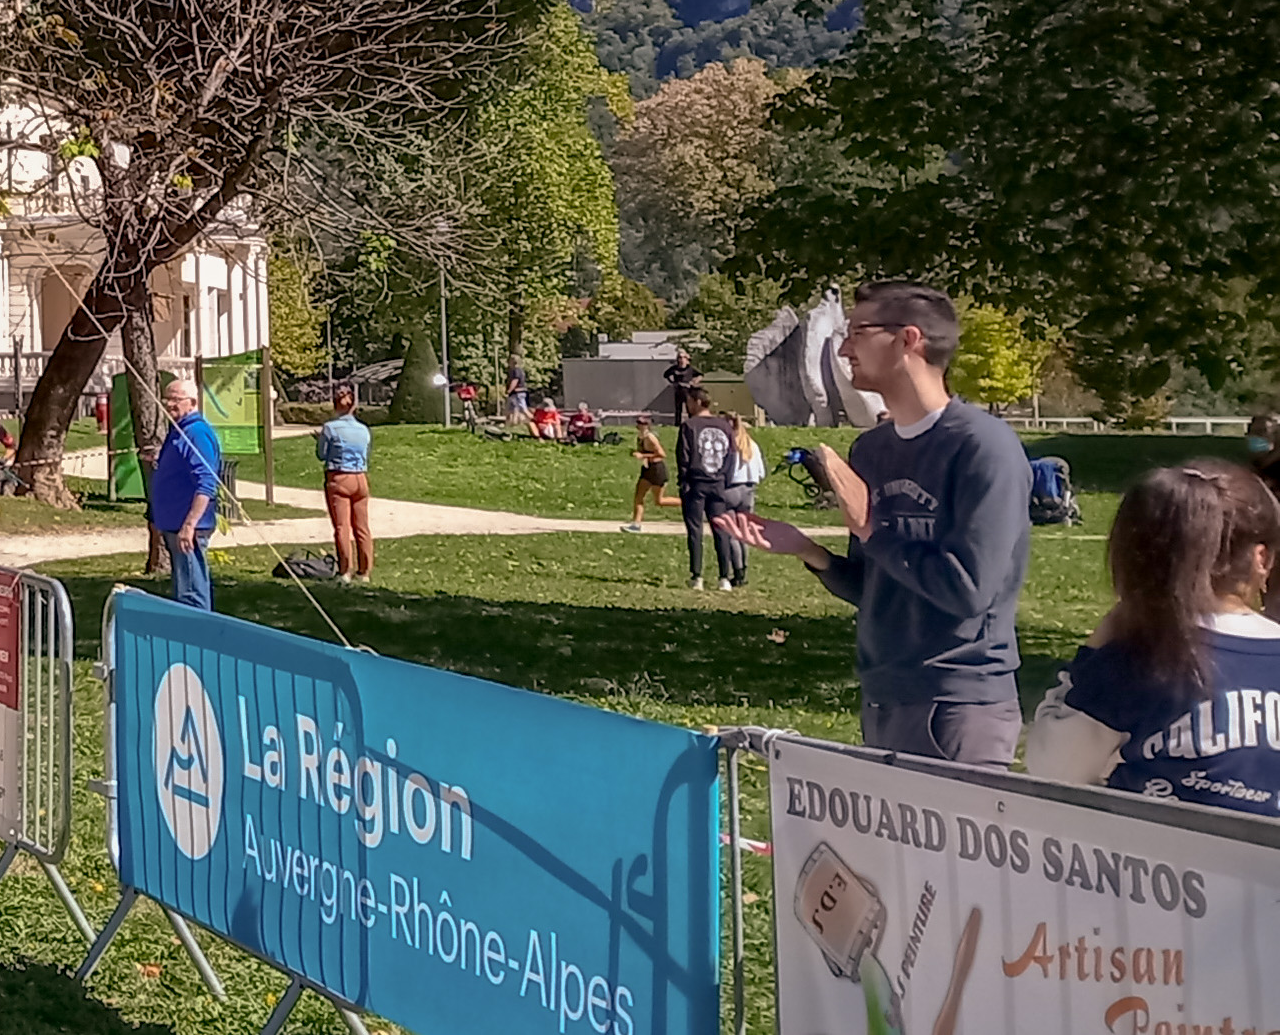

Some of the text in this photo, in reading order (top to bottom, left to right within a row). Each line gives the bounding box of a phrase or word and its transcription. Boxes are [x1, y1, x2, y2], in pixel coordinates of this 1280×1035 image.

[238, 695, 473, 861] La Région
[786, 776, 1207, 919] EDOUARD DOS SANTOS
[242, 814, 635, 1035] Auvergne-Rhône-Alpes
[901, 880, 937, 981] PEINTURE
[1001, 921, 1185, 987] Artisan
